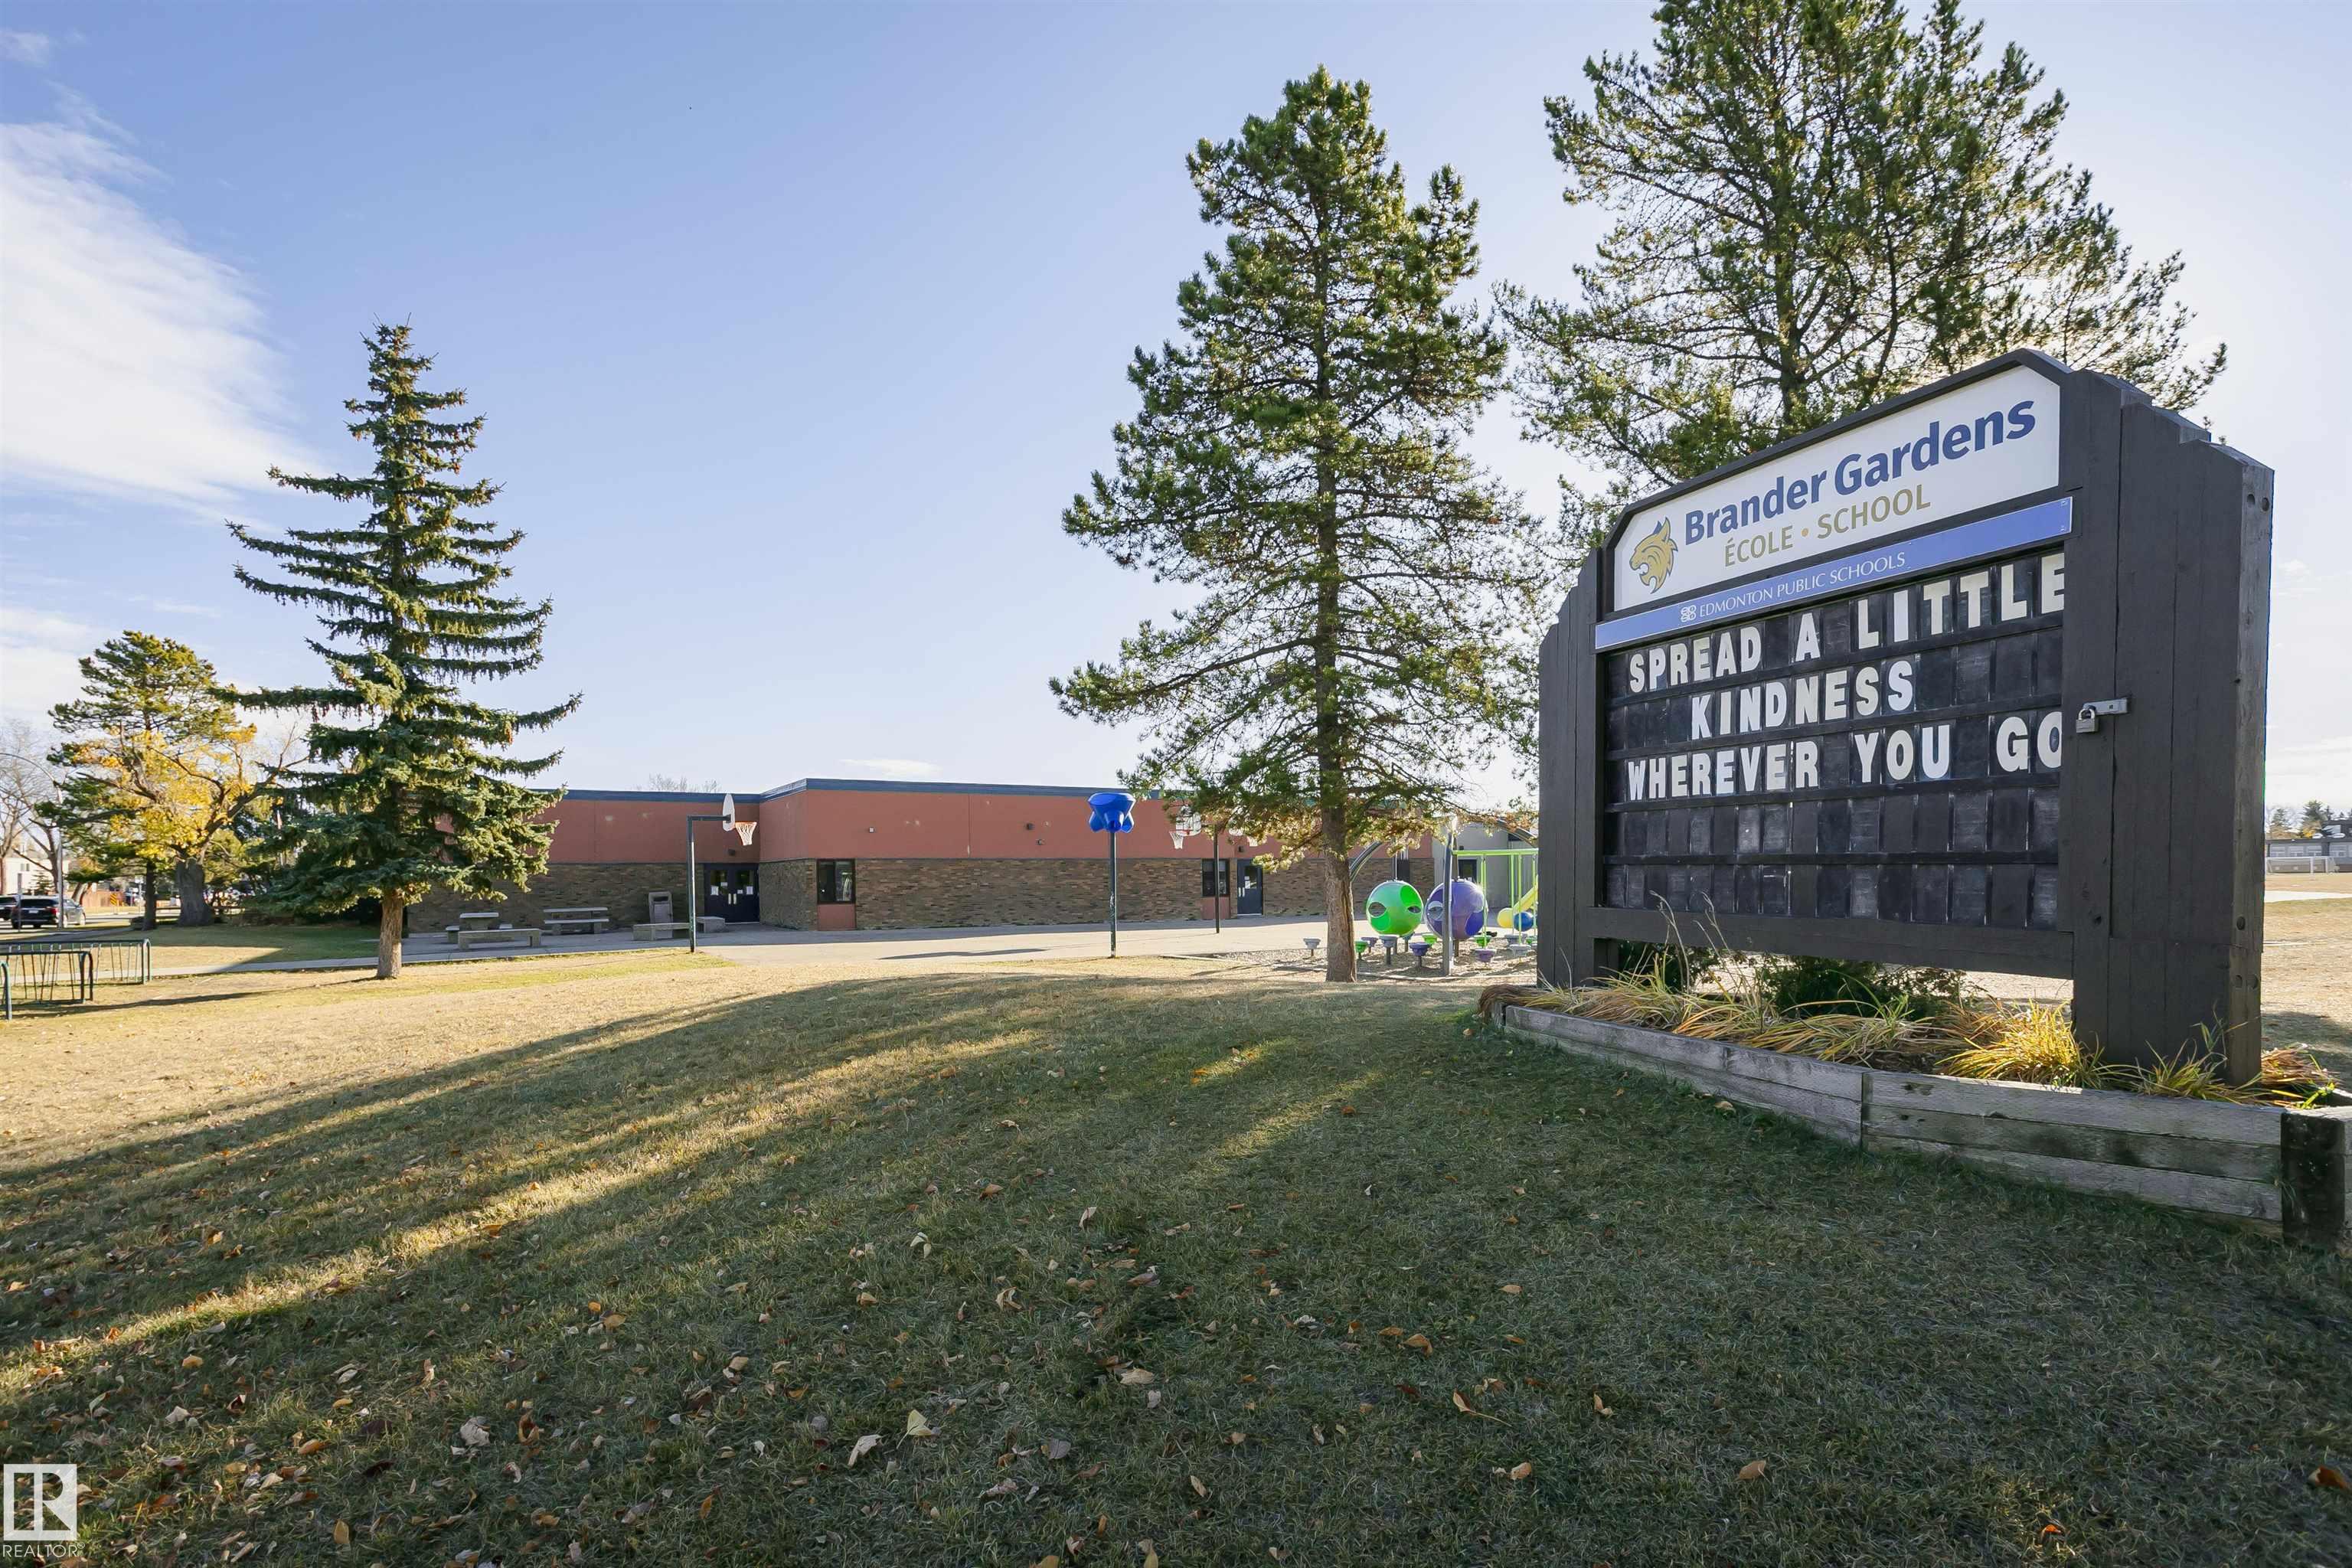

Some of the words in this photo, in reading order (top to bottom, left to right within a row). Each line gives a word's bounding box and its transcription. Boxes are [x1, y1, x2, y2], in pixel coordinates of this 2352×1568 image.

[1685, 470, 1828, 545] Brander
[1834, 400, 2036, 496] Gardens
[1724, 525, 1794, 567] ÉCOLE
[1817, 484, 1931, 539] SCHOOL
[1629, 626, 1762, 693] SPREAD
[1795, 612, 1821, 662] A
[1857, 552, 2065, 650] LITTLE
[1699, 586, 1773, 618] EDMONTON
[1776, 573, 1826, 597] PUBLIC
[1829, 551, 1906, 584] SCHOOLS
[1690, 660, 1914, 740] KINDNESS
[1627, 740, 1819, 801] WHEREVER
[1854, 724, 1951, 782] YOU
[1995, 710, 2063, 773] GO
